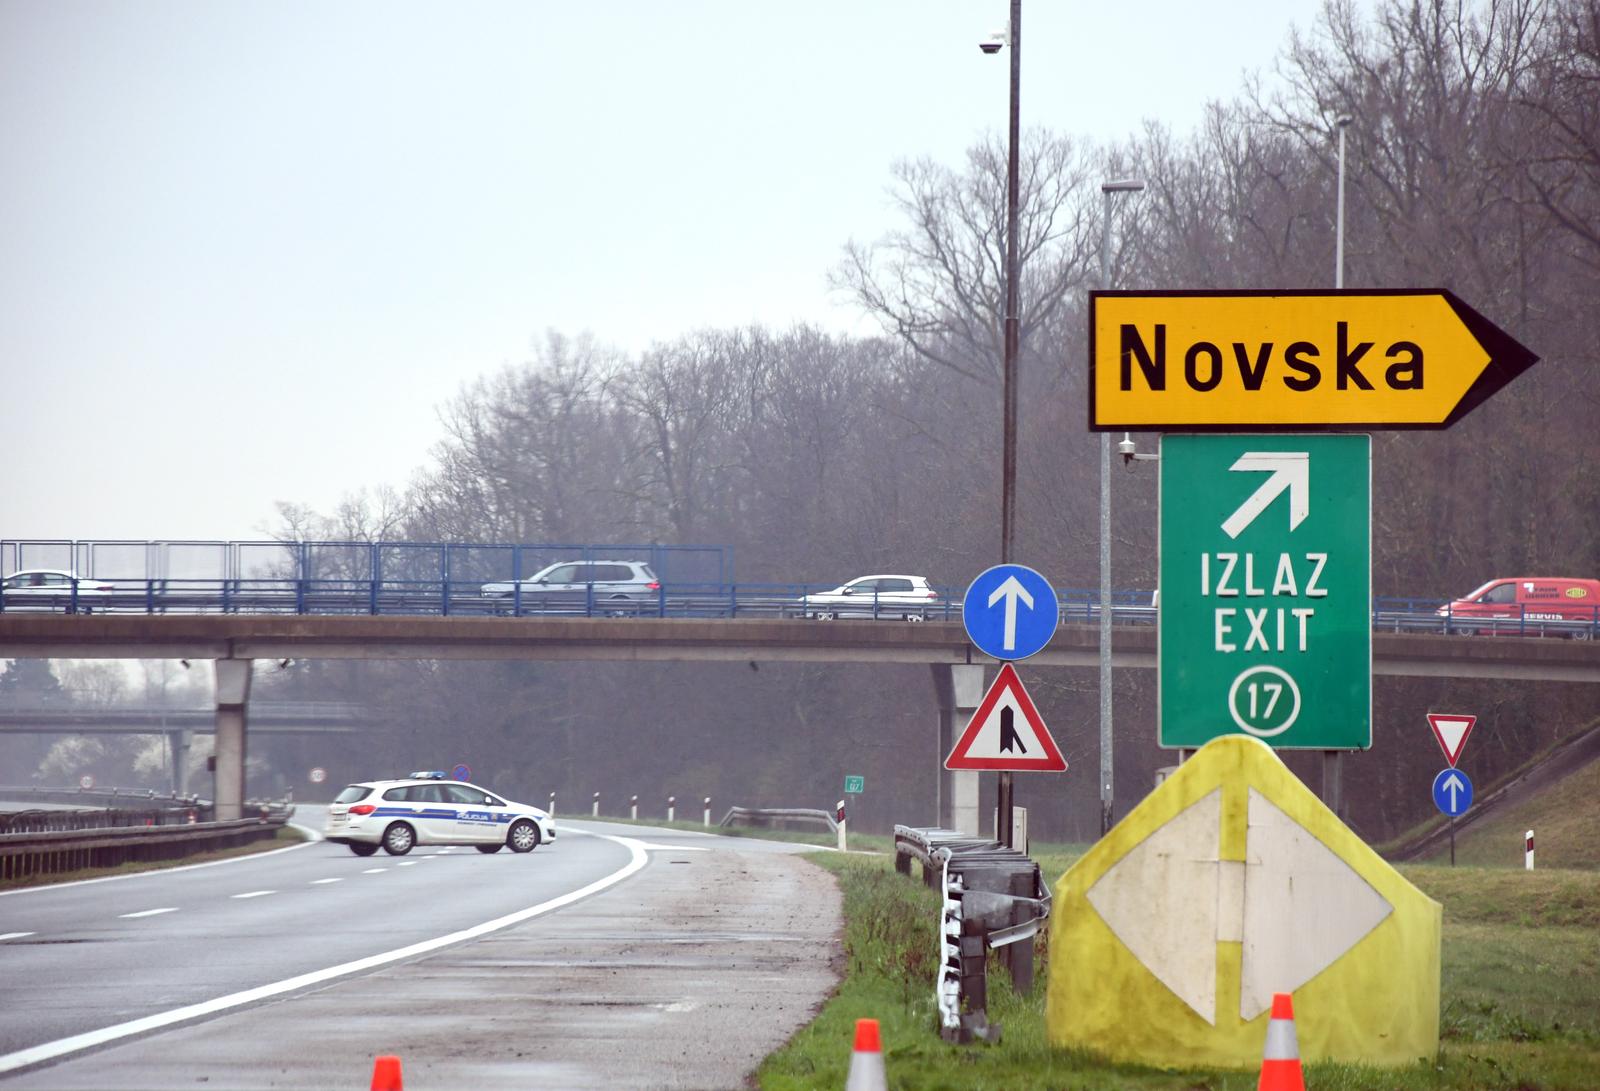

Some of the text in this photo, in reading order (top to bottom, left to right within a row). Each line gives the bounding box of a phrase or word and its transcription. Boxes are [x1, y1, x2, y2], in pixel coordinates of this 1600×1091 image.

[1119, 321, 1425, 392] Novska
[1201, 552, 1329, 596] IZLAZ
[1214, 607, 1315, 653] EXIT
[1247, 682, 1283, 719] 17
